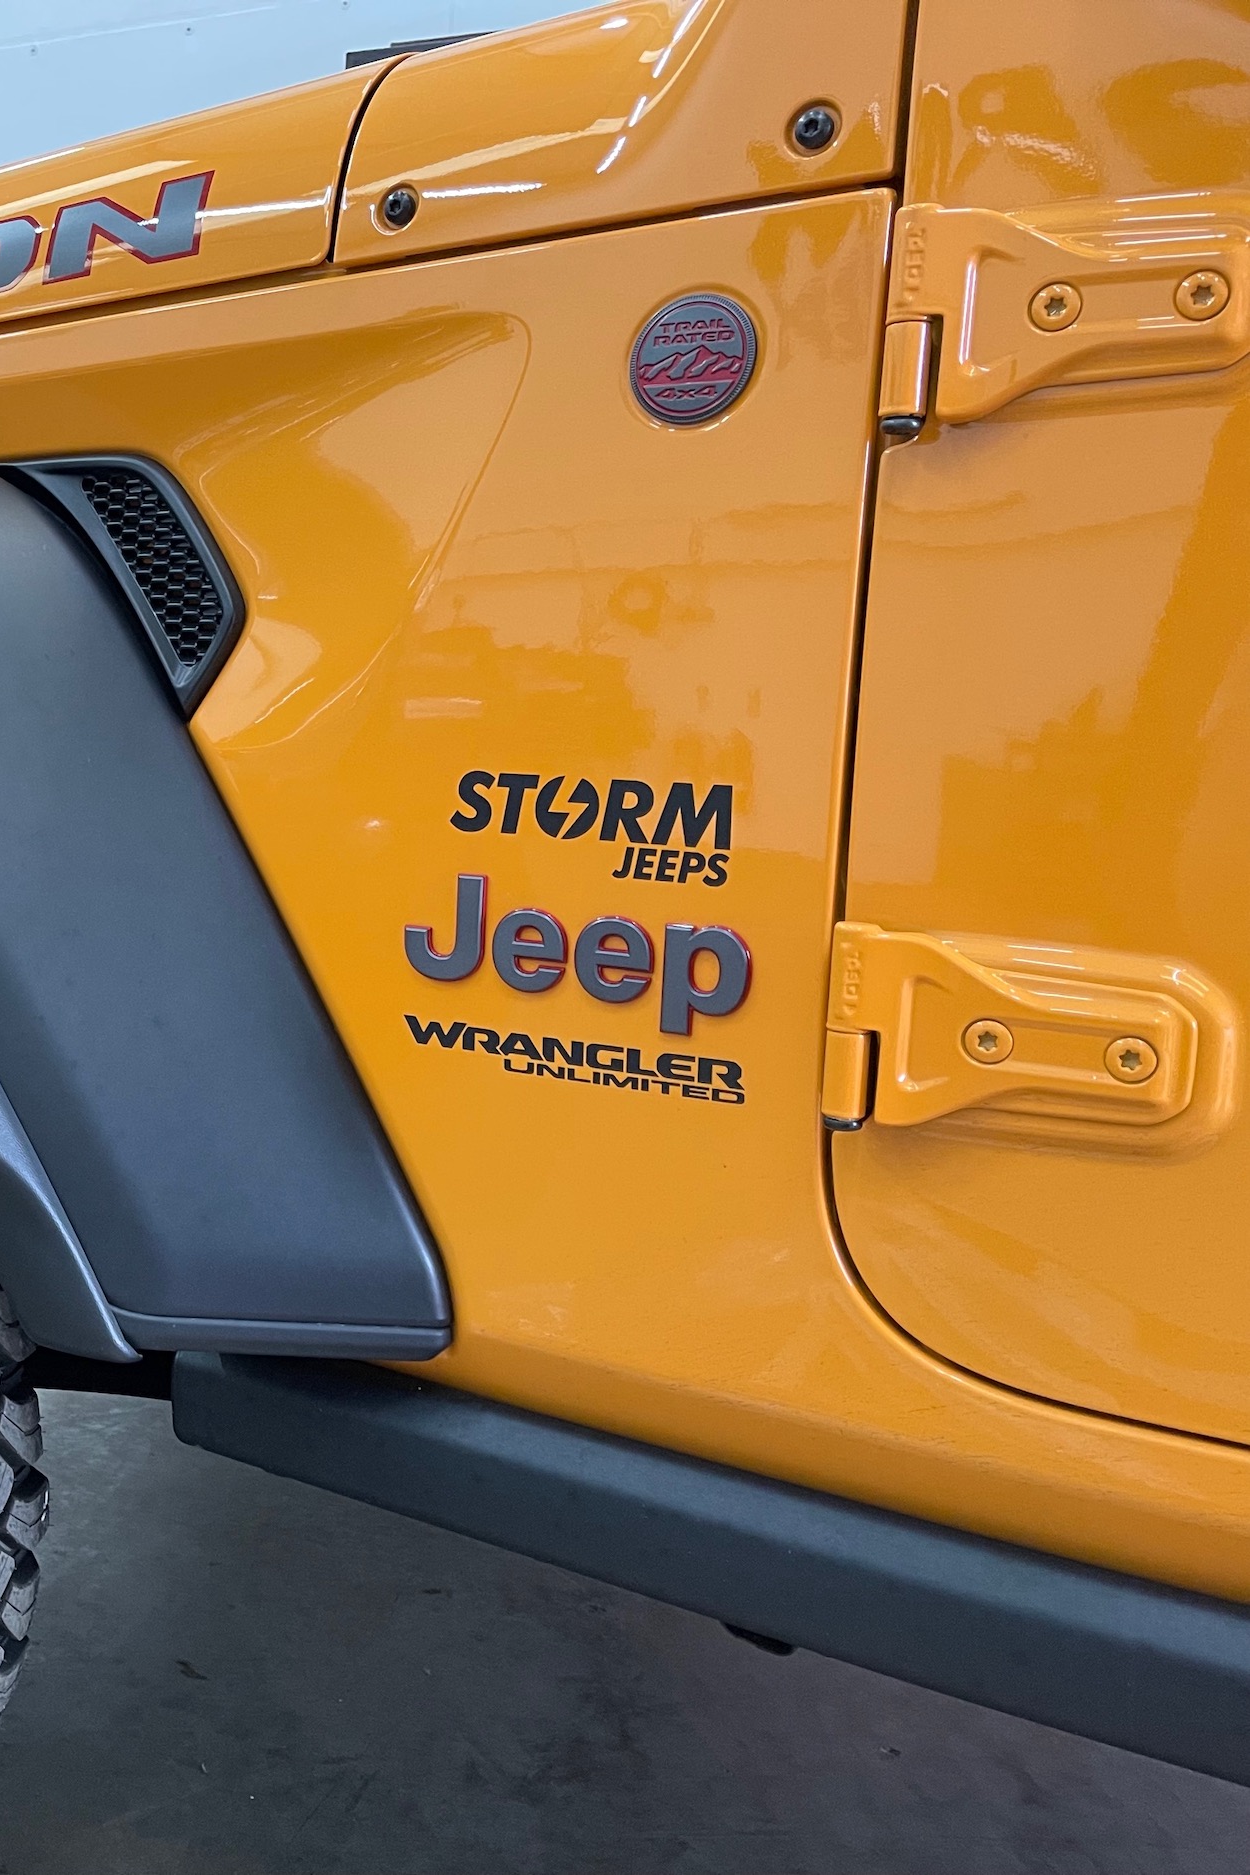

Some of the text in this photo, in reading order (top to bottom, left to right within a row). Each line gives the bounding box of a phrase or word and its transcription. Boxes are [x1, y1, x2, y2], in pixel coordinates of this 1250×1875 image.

[653, 330, 735, 346] RATED
[659, 318, 731, 334] TRAIL
[450, 770, 733, 850] STORM
[612, 847, 730, 887] JEEPS
[404, 873, 751, 1036] Jeep
[403, 1014, 745, 1090] WRANGLER
[503, 1058, 745, 1105] UNLIMITED
